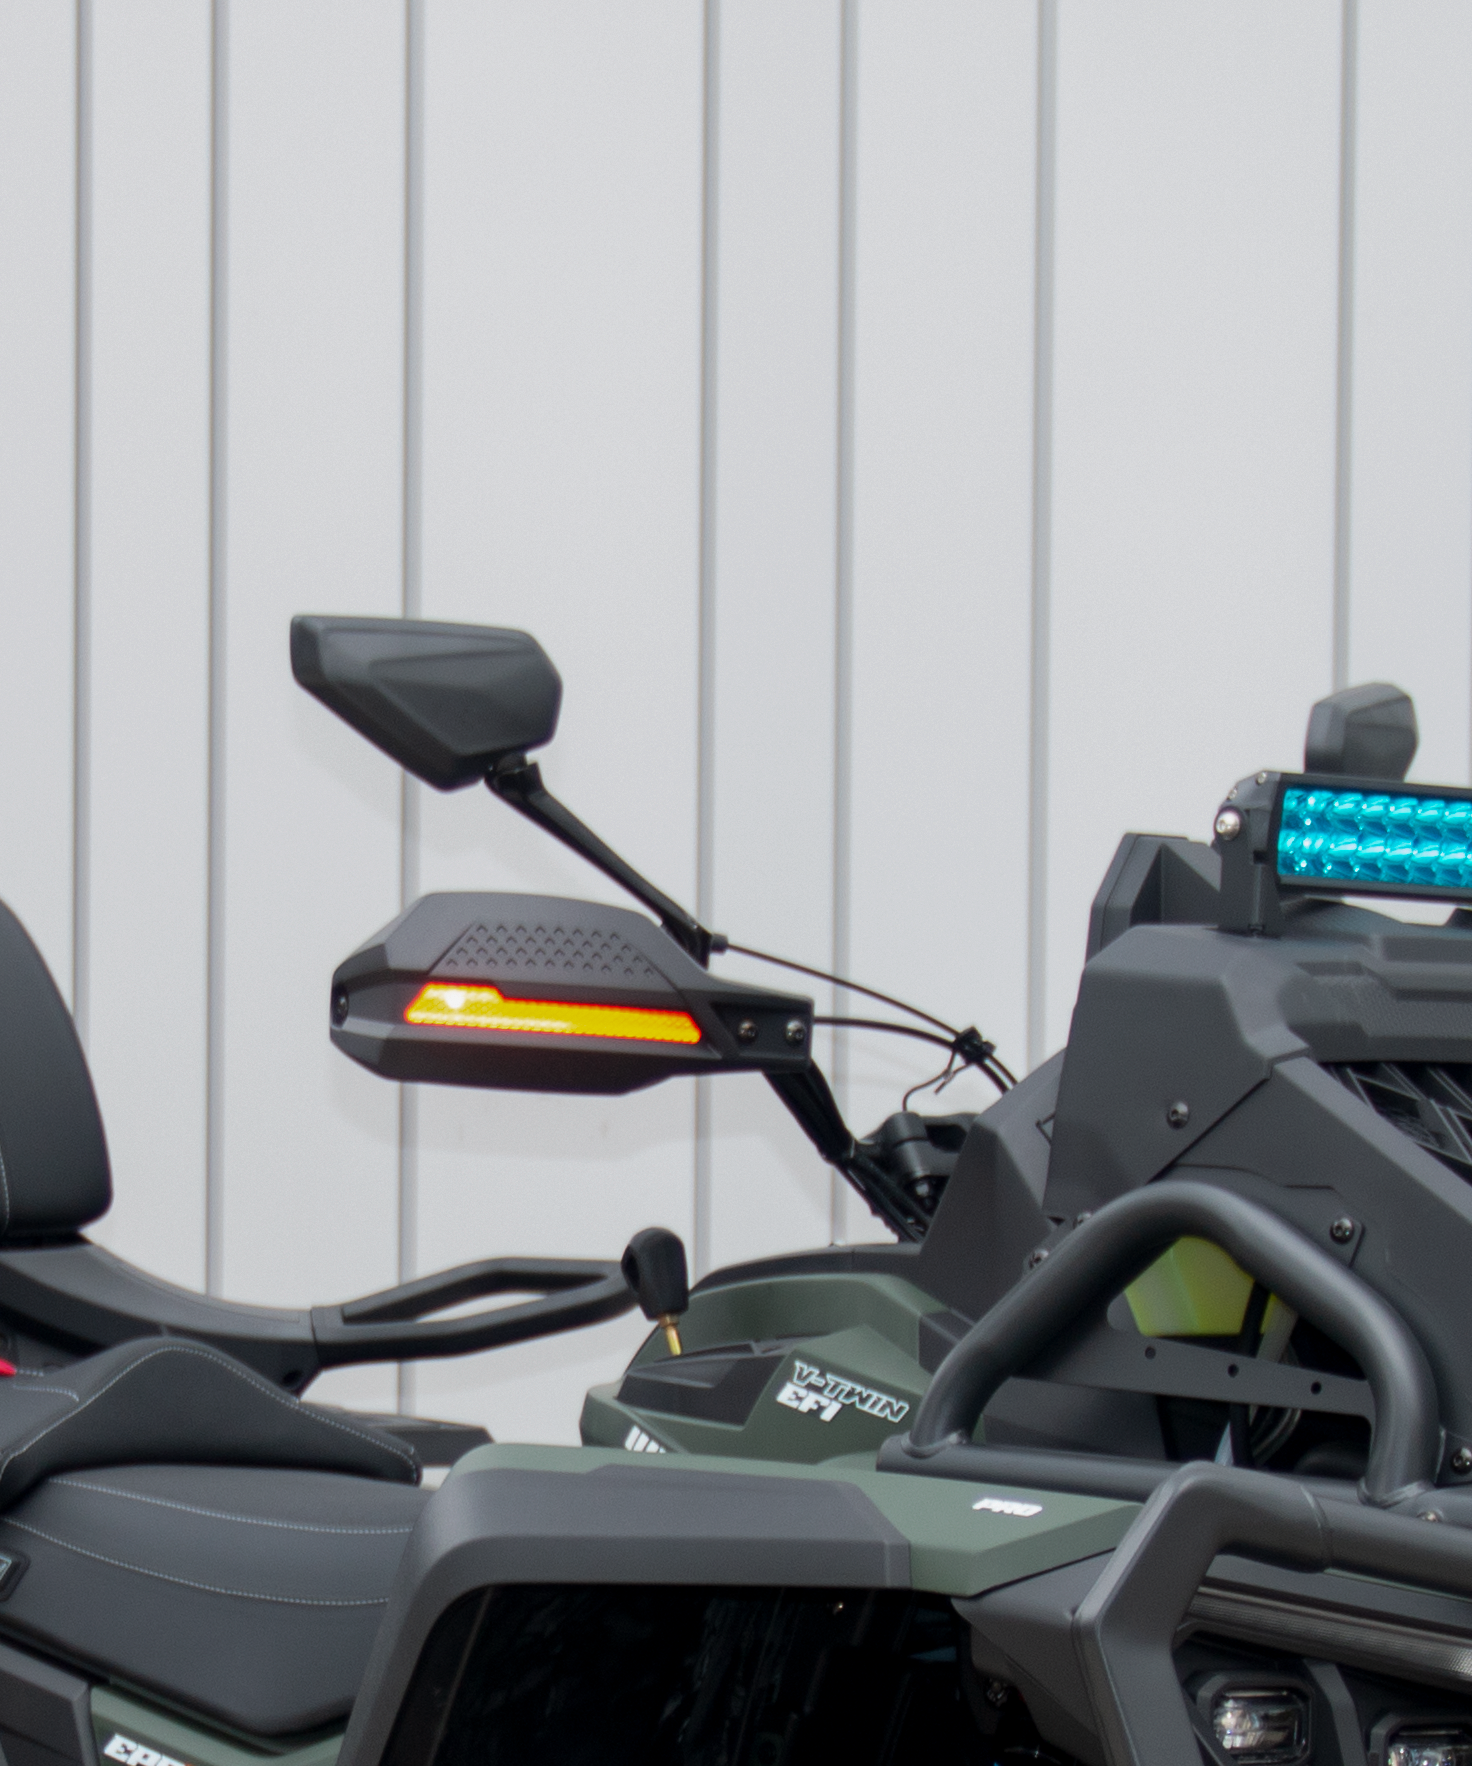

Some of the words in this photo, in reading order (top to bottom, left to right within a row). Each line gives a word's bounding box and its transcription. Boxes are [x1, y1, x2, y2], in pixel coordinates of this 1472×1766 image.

[776, 1382, 842, 1422] EFI
[792, 1359, 910, 1423] V-TWIN
[972, 1498, 1043, 1517] PRO
